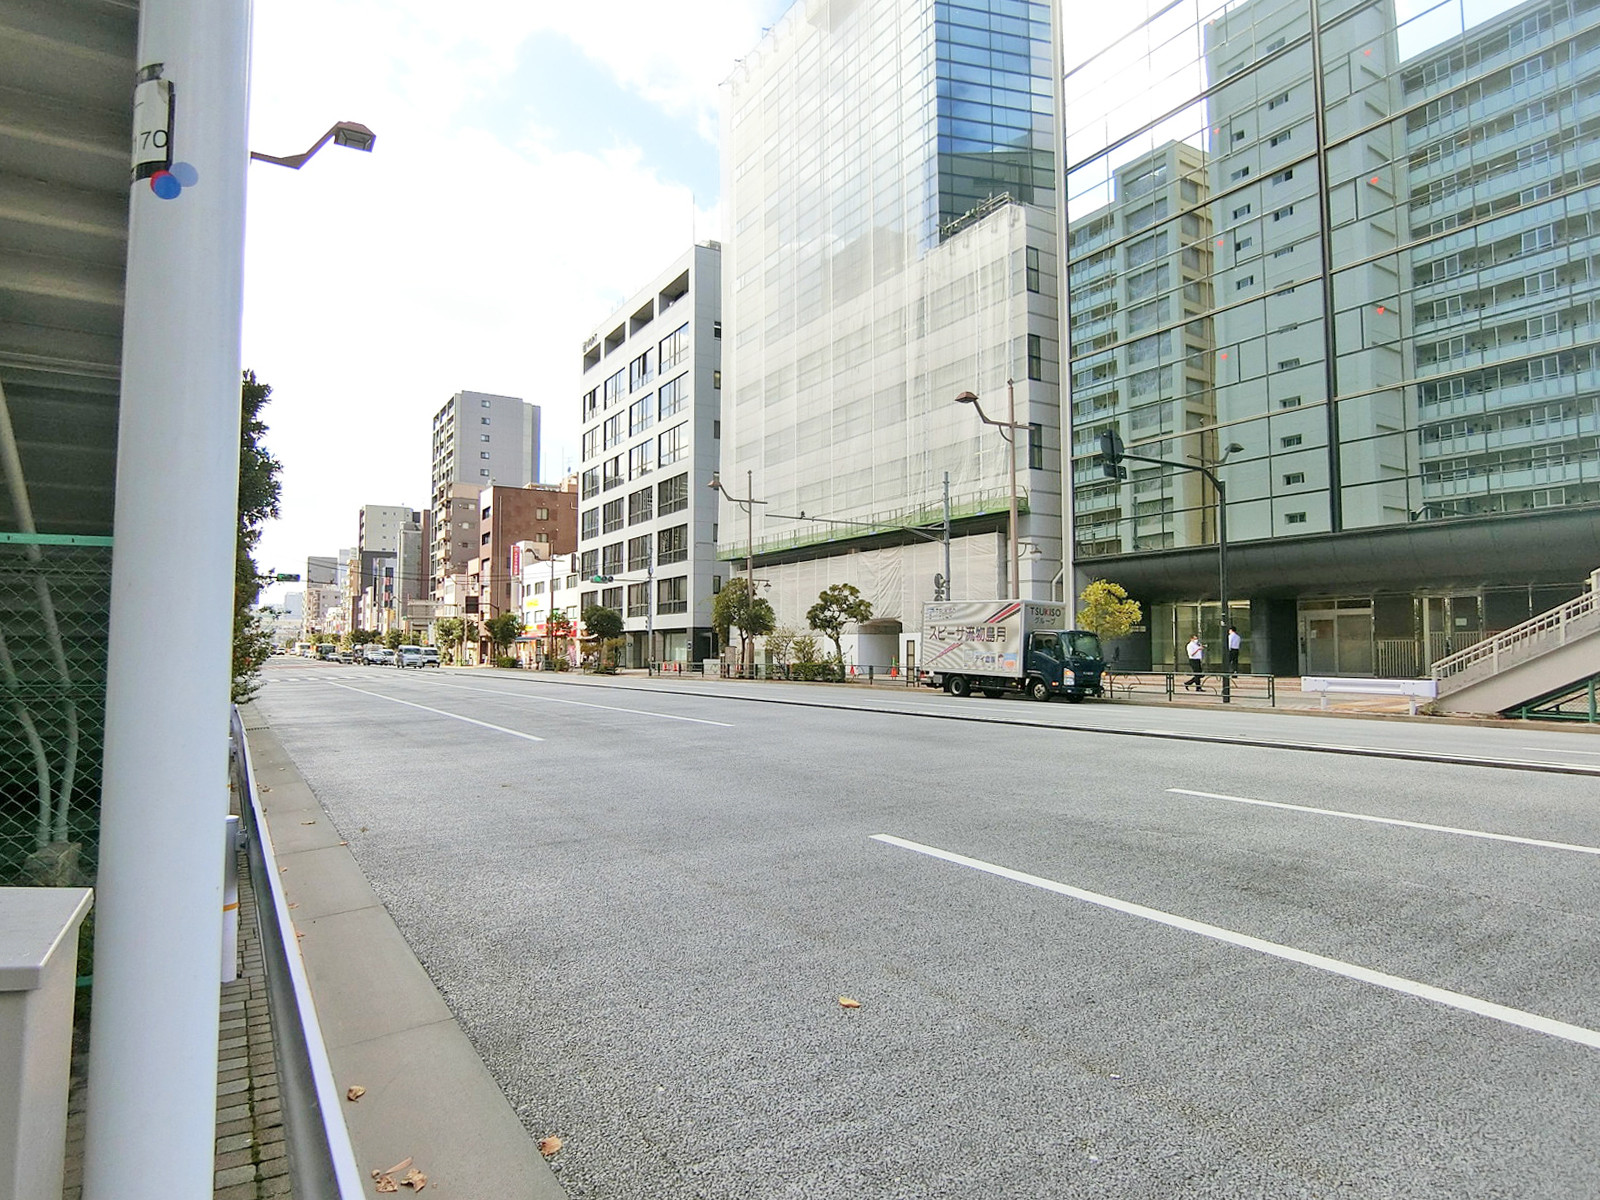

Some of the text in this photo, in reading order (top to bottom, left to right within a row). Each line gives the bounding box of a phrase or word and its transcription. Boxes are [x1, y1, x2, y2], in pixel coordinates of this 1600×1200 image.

[1030, 606, 1061, 617] TSUKISO
[1034, 616, 1056, 625] グループ
